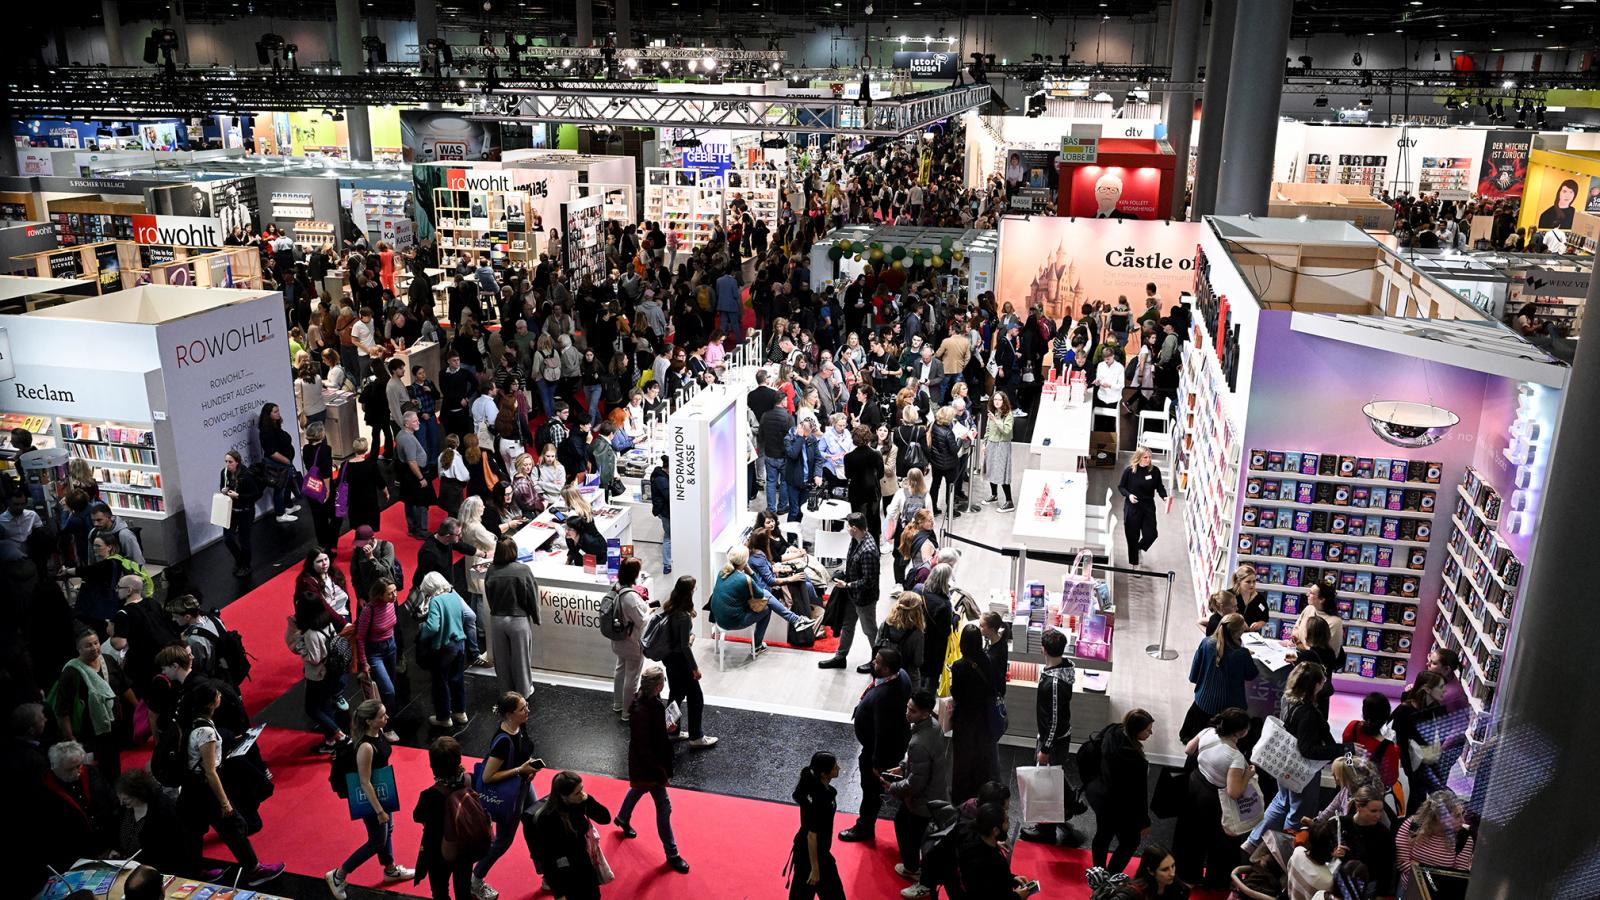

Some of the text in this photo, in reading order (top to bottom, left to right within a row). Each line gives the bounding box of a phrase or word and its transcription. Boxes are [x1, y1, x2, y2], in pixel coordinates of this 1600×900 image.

[1125, 127, 1143, 137] dtv
[440, 145, 463, 155] WAS
[1397, 136, 1418, 148] dtv
[1492, 142, 1529, 151] DER WITCHER
[687, 152, 731, 163] GEBIETE
[100, 181, 125, 189] VERLAGE
[451, 175, 509, 191] rowohlt
[27, 226, 53, 237] rowohlt
[138, 223, 217, 247] rowohlt
[51, 255, 74, 264] BERNHARD
[1105, 250, 1173, 270] Castle
[1549, 279, 1574, 288] WENZ
[176, 318, 272, 369] ROWOHLT
[210, 369, 246, 389] ROWOHLT
[15, 383, 75, 402] Reclam
[201, 383, 260, 411] HUNDERT AUGEN
[203, 399, 263, 429] ROWOHLT BERLIN
[675, 426, 685, 501] INFORMATION
[686, 444, 696, 486] & KASSE
[553, 609, 563, 625] &
